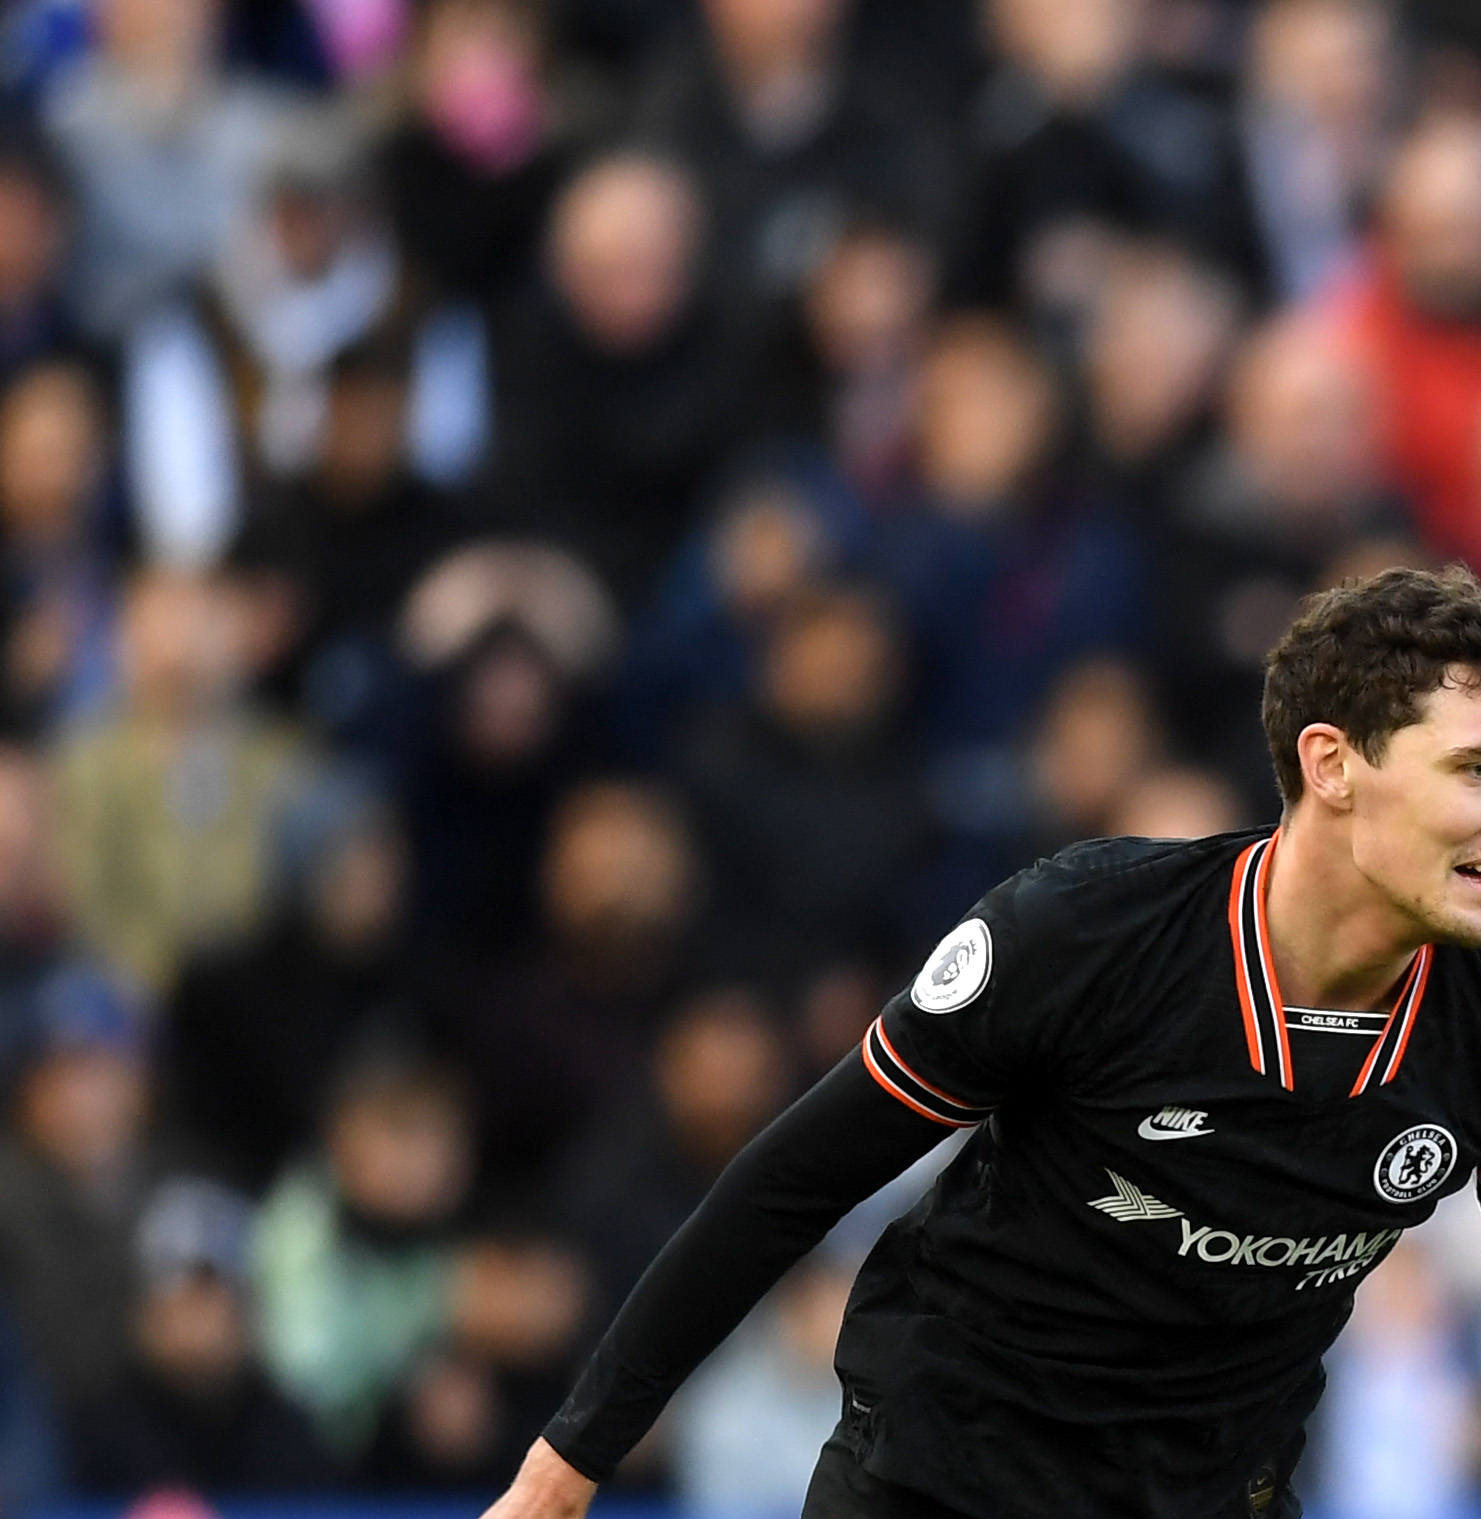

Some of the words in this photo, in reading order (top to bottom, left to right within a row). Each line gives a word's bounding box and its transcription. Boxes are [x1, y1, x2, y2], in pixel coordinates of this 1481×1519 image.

[1301, 1014, 1345, 1027] CHELSEA
[1346, 1018, 1359, 1028] FC
[1152, 1104, 1209, 1133] NIKE
[1399, 1130, 1447, 1147] CHELSEA
[1177, 1217, 1401, 1268] YOKOHAMA
